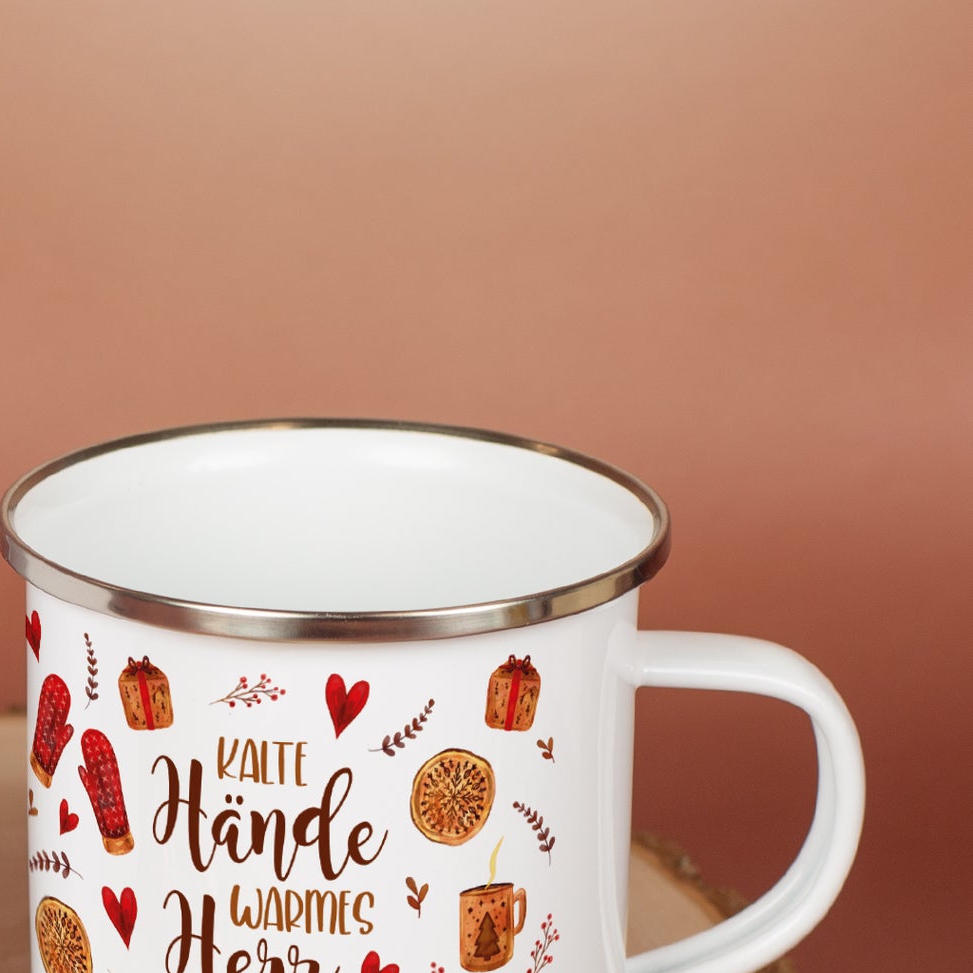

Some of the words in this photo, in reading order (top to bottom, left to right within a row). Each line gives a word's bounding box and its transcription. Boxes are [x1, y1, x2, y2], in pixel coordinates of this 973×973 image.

[217, 736, 308, 787] KALTE
[151, 754, 389, 882] Hände
[230, 884, 375, 936] WARMES
